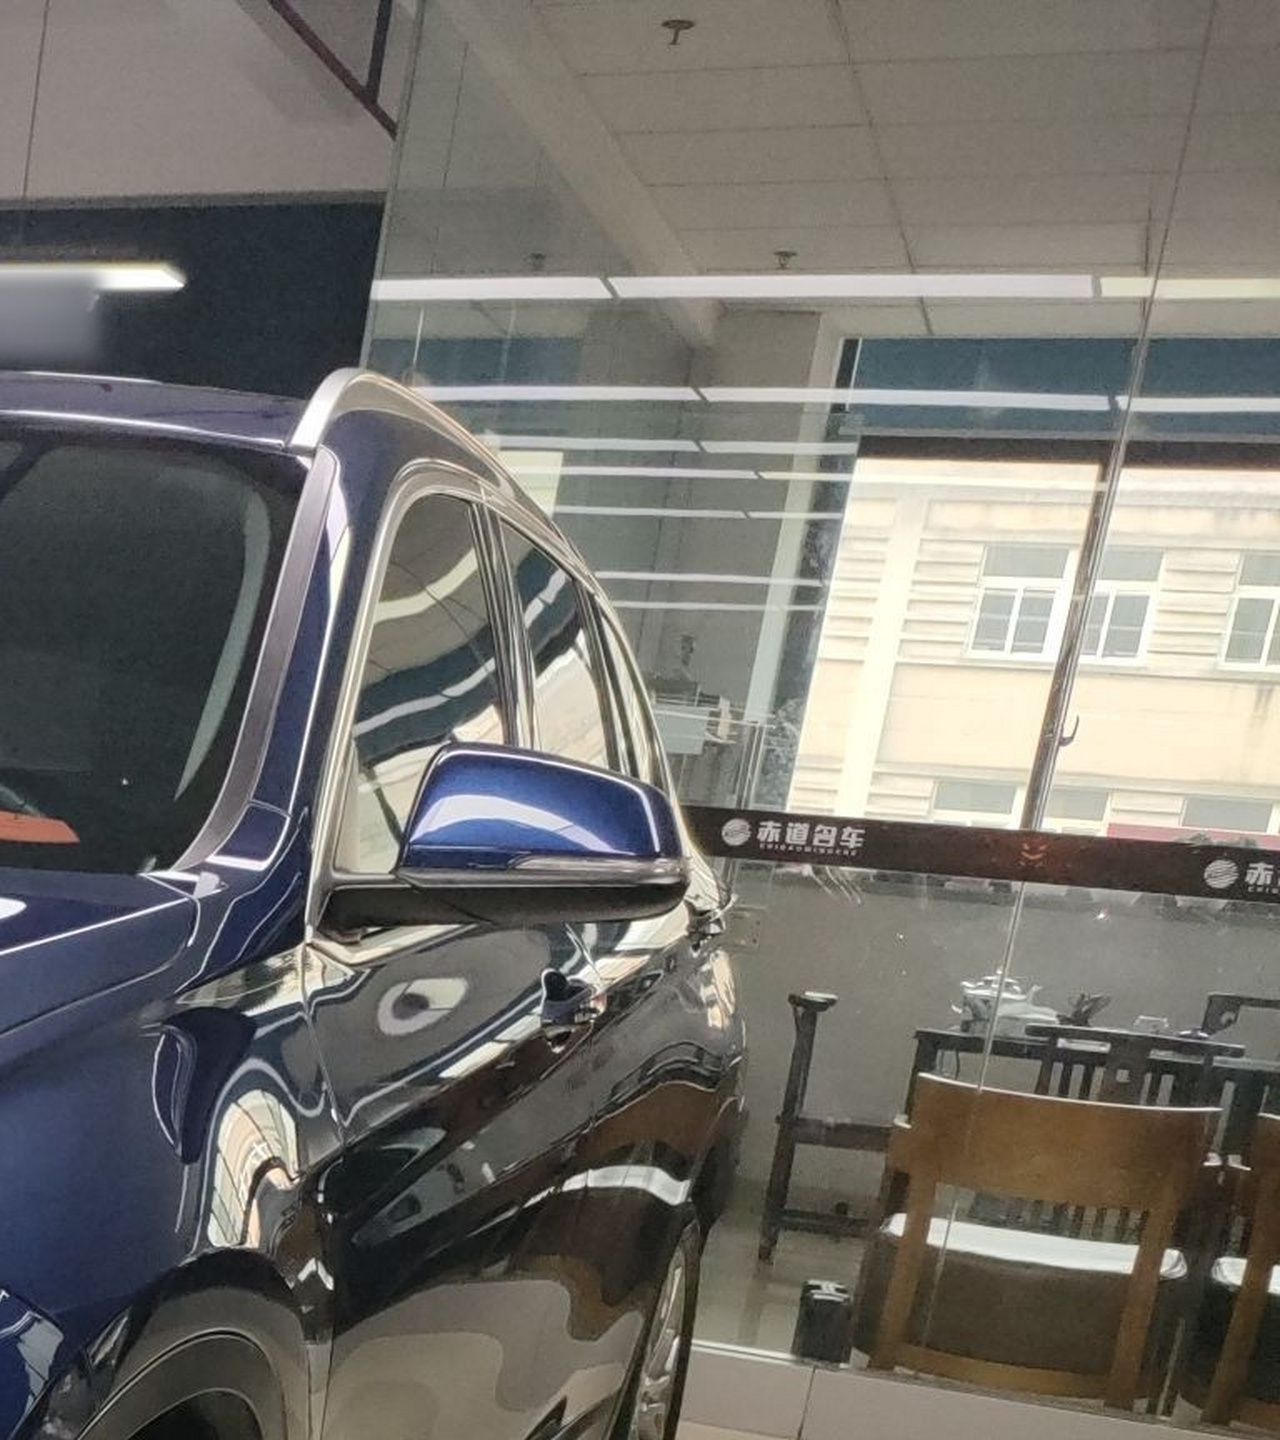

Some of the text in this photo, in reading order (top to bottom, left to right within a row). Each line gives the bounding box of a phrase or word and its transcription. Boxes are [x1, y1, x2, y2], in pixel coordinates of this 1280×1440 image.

[757, 820, 866, 849] 赤道名车
[1245, 862, 1280, 886] 赤
